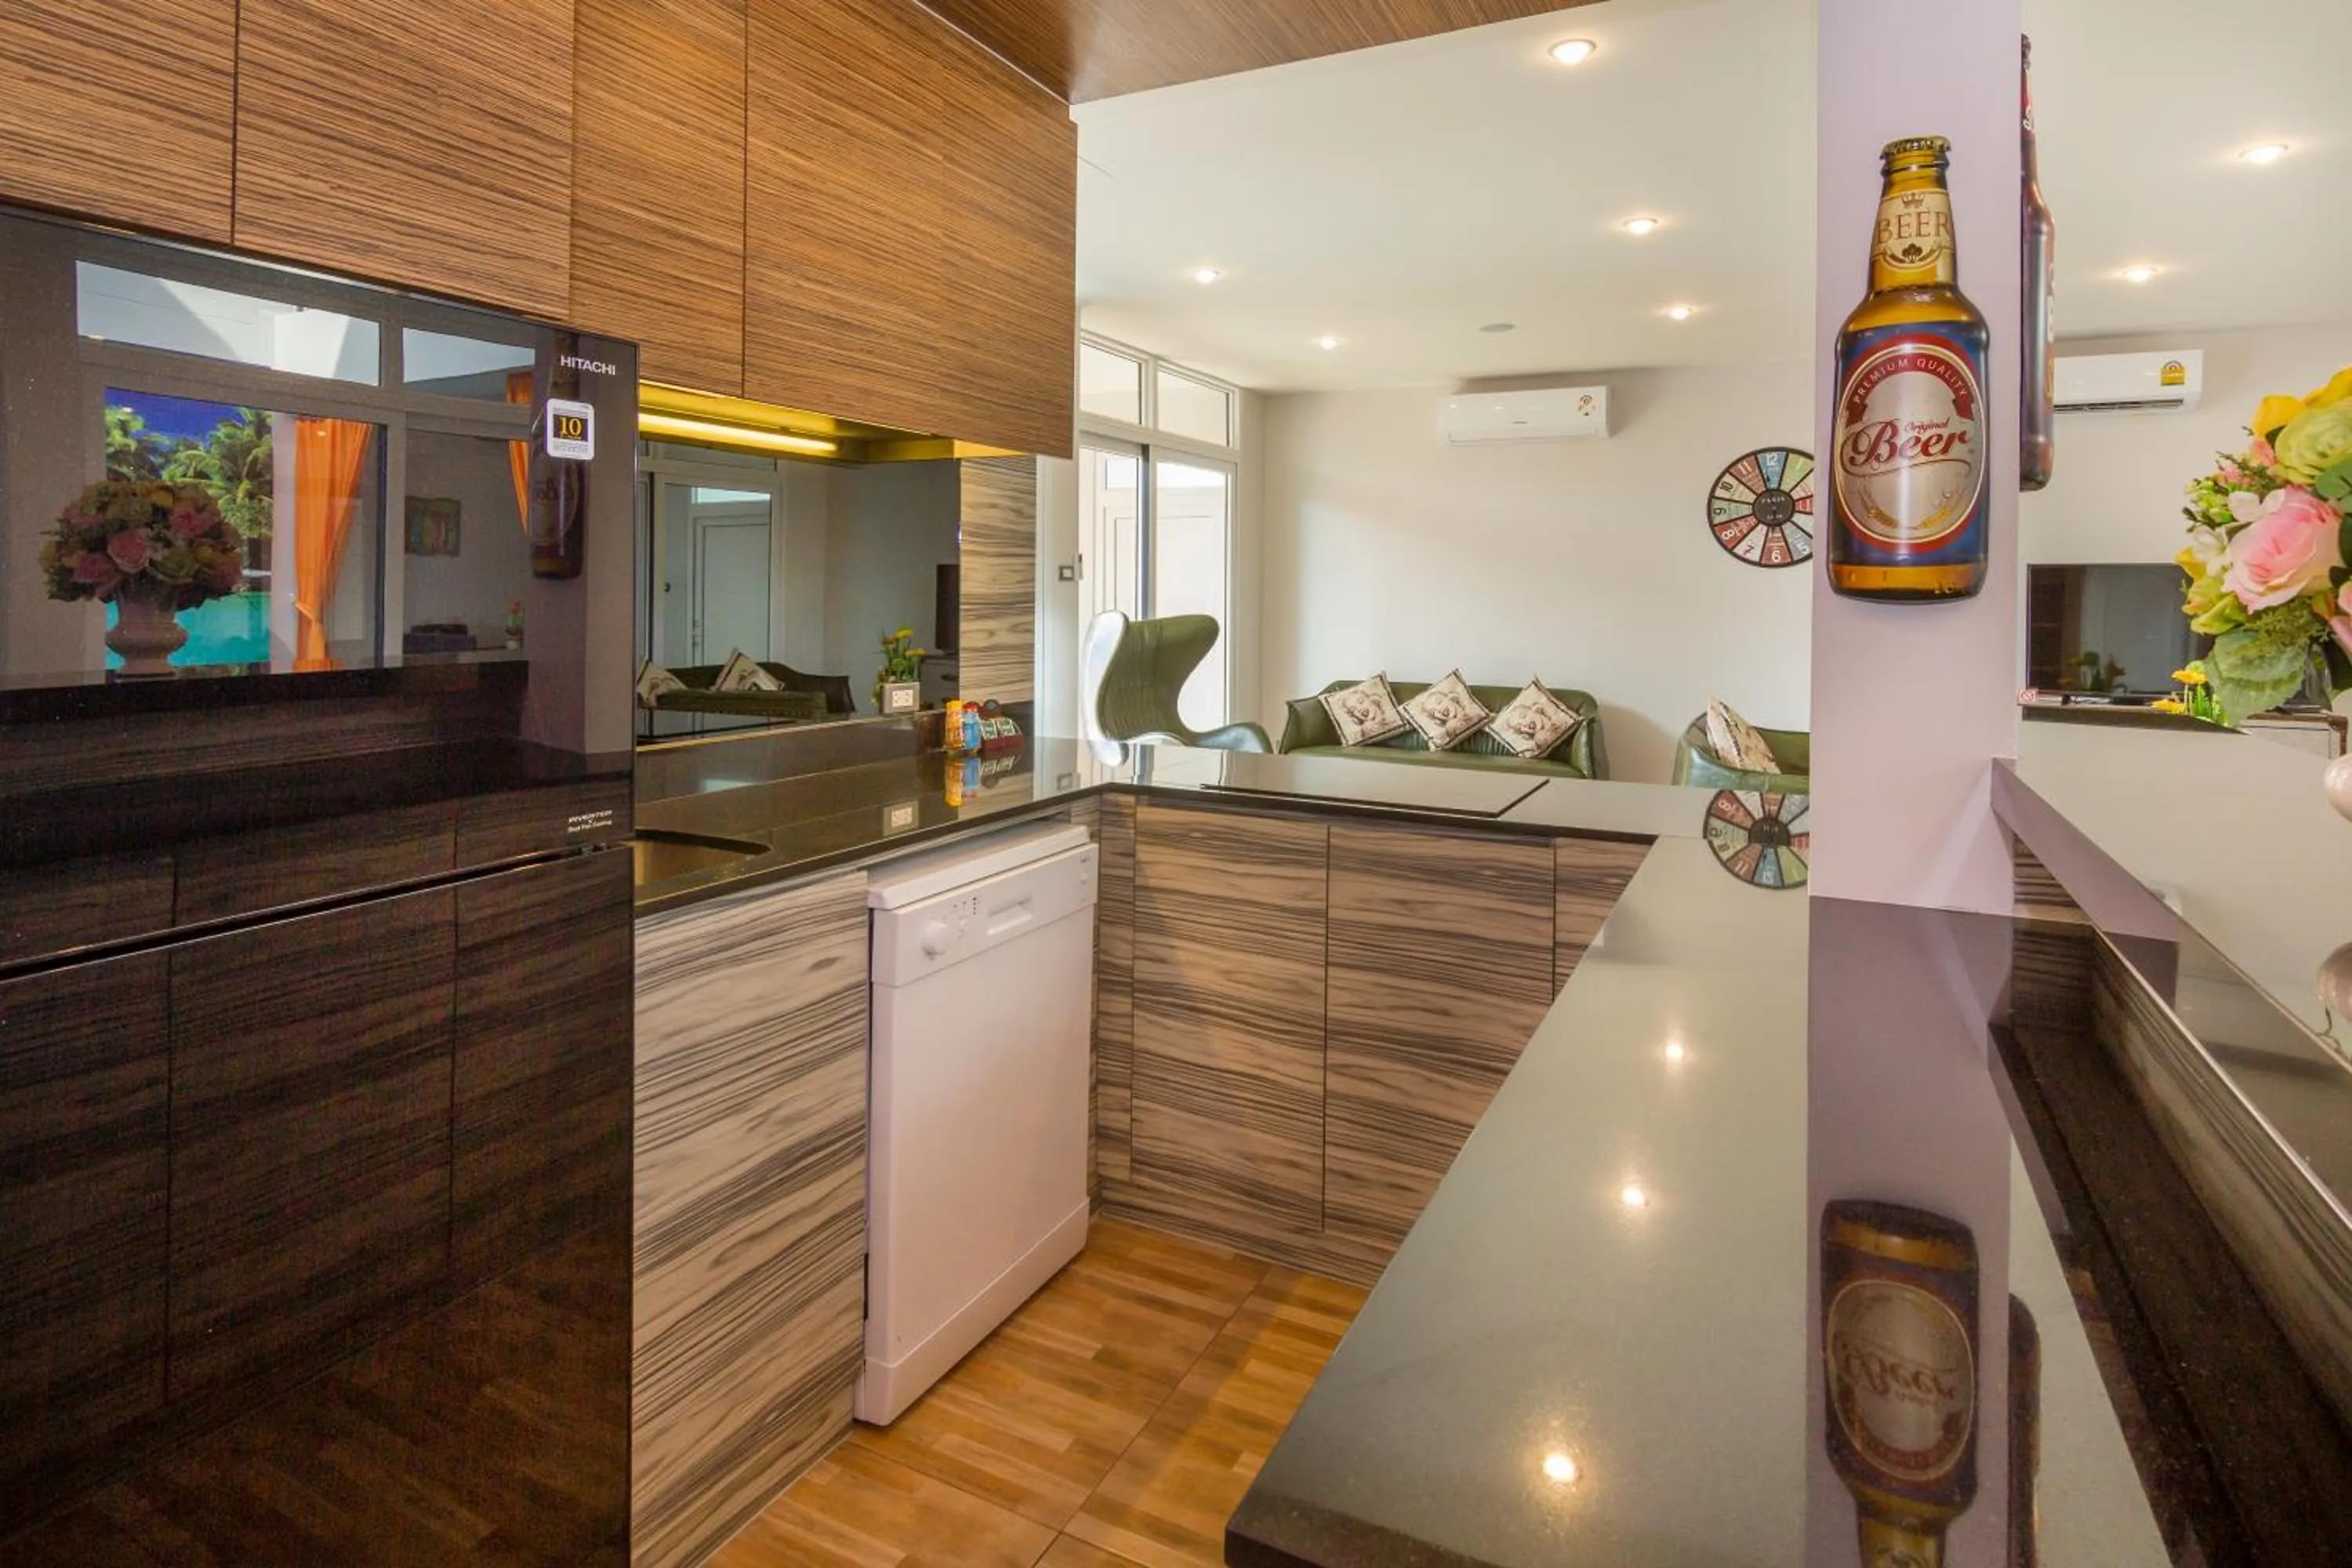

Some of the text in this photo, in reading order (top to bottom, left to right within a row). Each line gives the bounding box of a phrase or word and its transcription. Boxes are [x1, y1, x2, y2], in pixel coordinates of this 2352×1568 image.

[1876, 211, 1950, 245] BEER
[561, 354, 615, 376] HITACHI
[1853, 358, 1969, 404] PREMIUM QUALITY
[559, 416, 583, 435] 10
[1904, 416, 1951, 435] Original
[1842, 418, 1971, 469] Beer
[1766, 453, 1779, 466] 12
[1721, 529, 1734, 540] 8
[1771, 550, 1781, 562] 6
